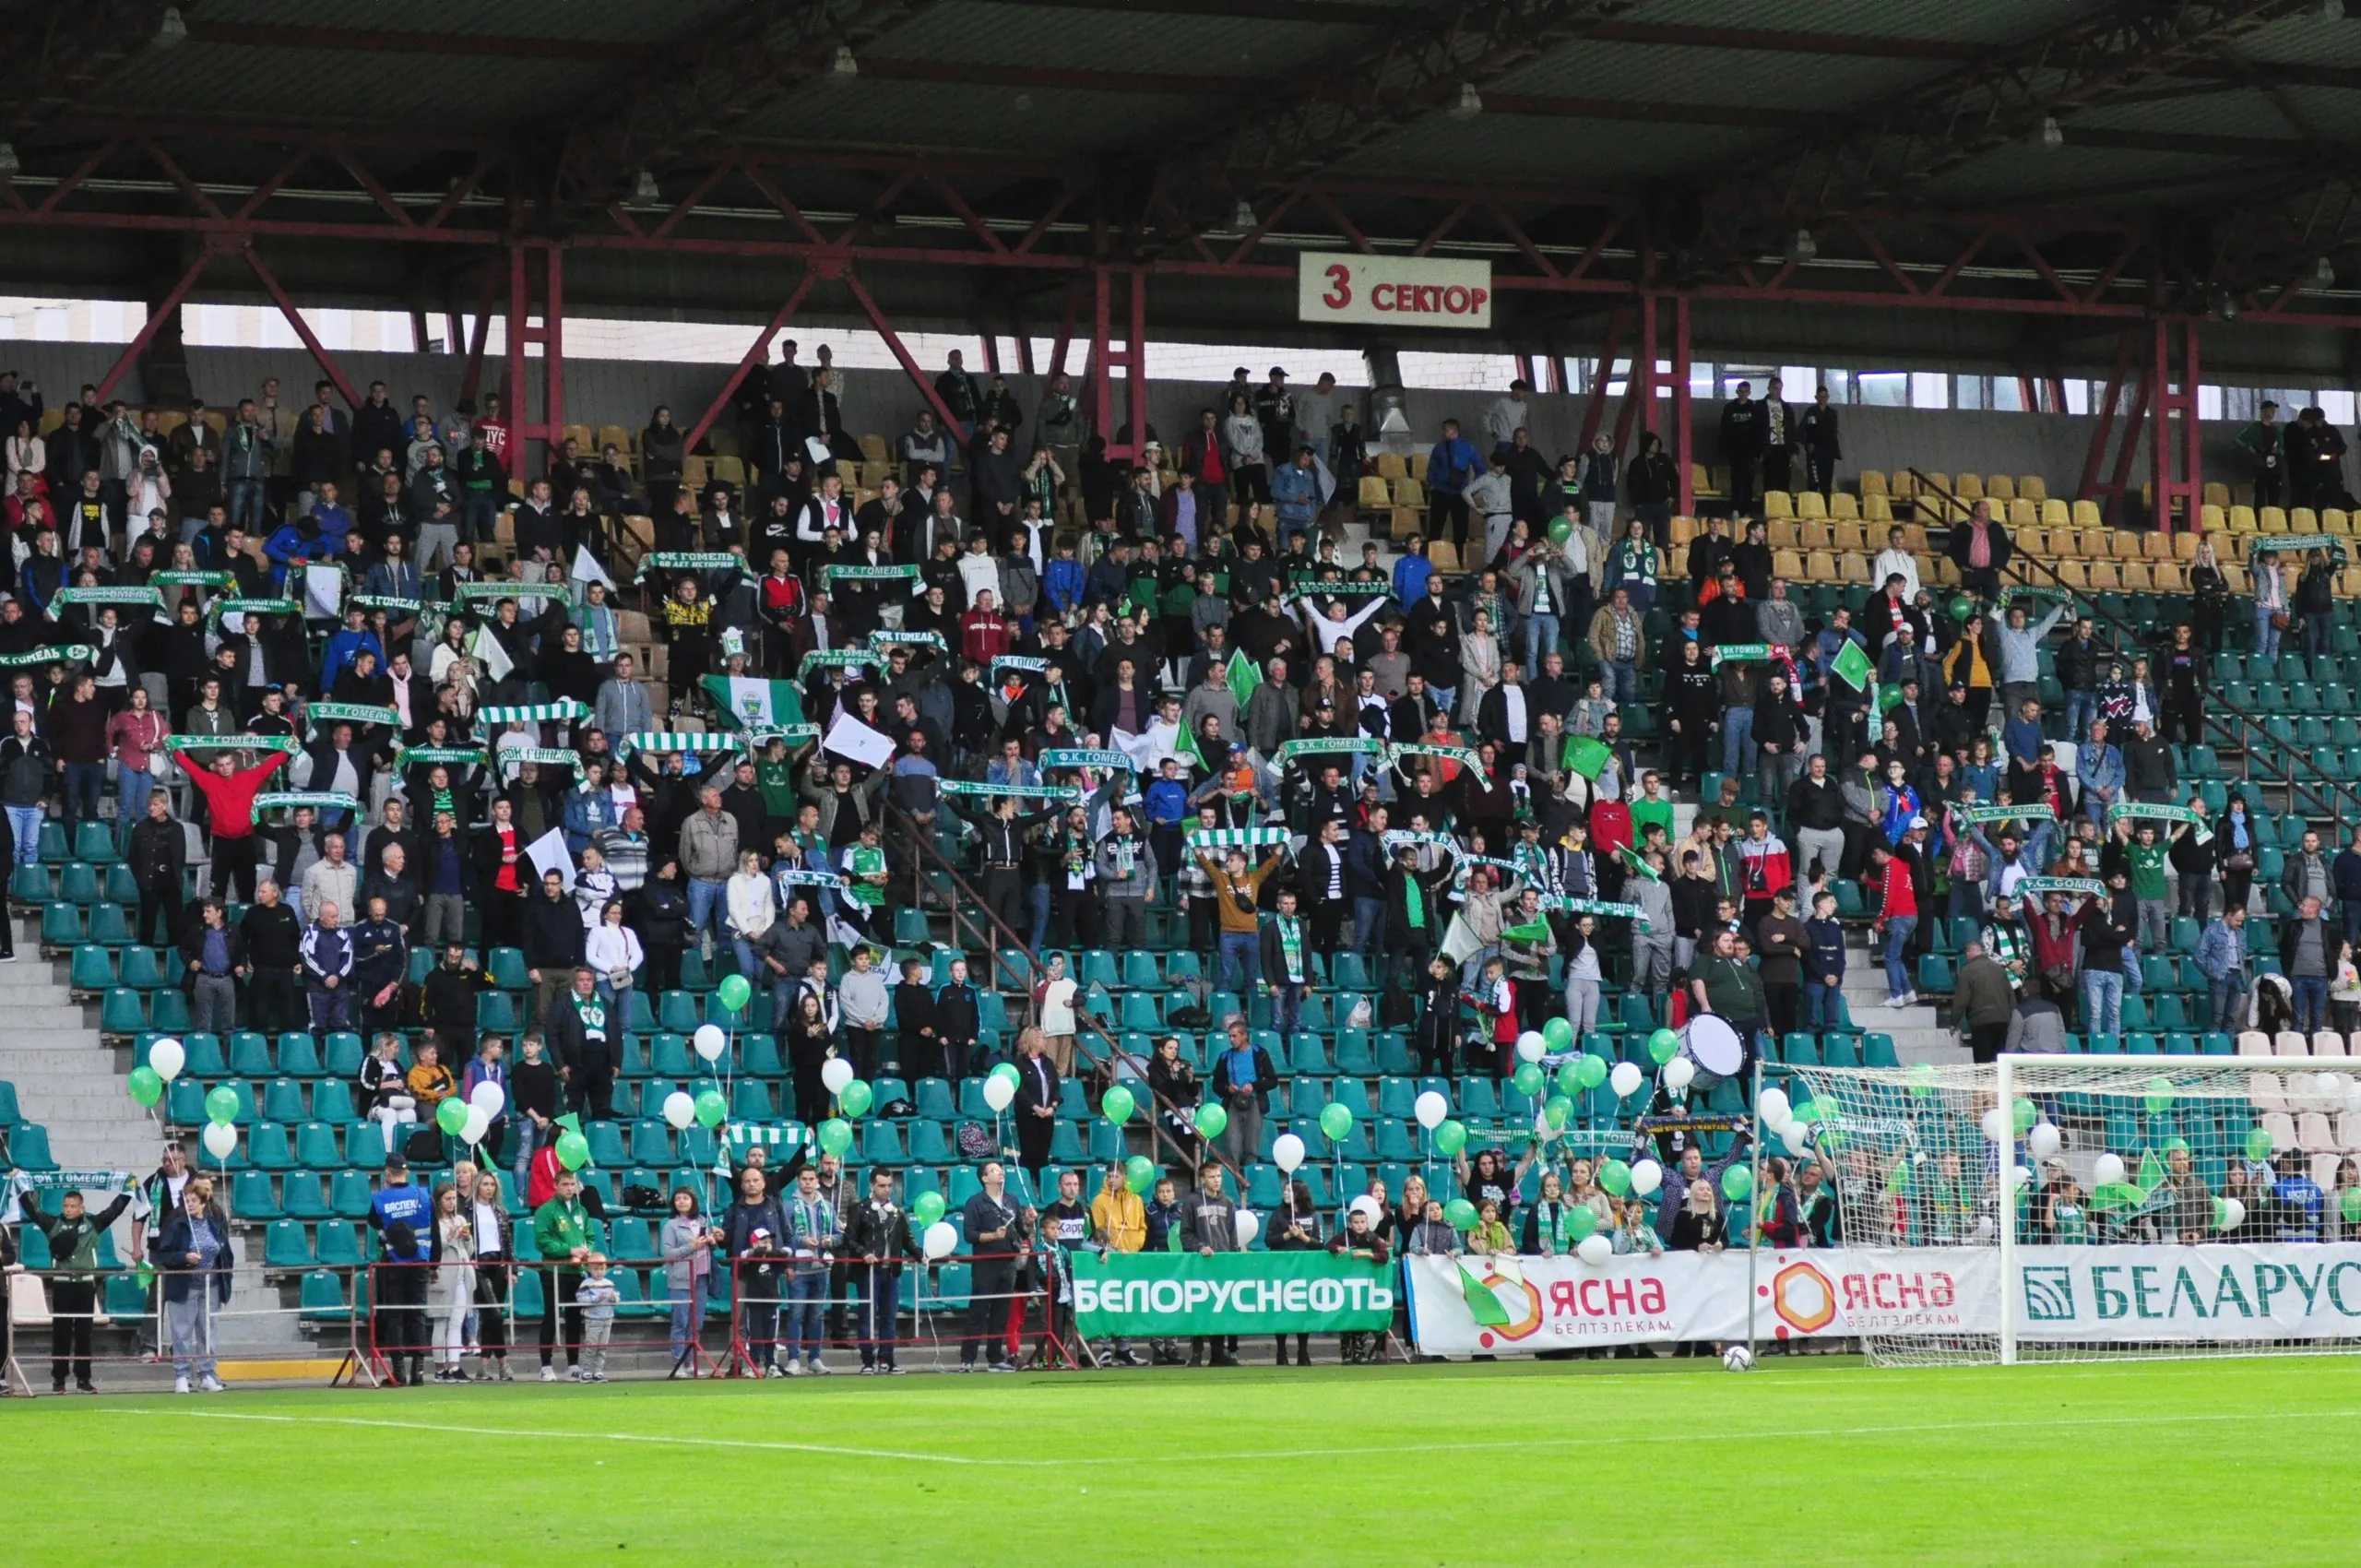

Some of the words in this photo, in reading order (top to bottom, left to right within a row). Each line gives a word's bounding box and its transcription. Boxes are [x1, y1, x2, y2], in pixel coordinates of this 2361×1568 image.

[1323, 264, 1352, 310] 3
[1370, 283, 1489, 315] СЕКТОР
[681, 552, 735, 562] ГОМЕЛЬ
[860, 565, 905, 576] ГОМЕЛЬ
[375, 596, 421, 610] ГОМЕЛЬ
[895, 632, 935, 643] ГОМЕЛЬ
[12, 647, 61, 665] ГОМЕЛЬ
[1735, 646, 1764, 654] ГОМЕЛЬ
[317, 705, 341, 715] Ф.К.
[344, 707, 391, 721] ГОМЕЛЬ
[213, 735, 269, 744] ГОМЕЛЬ
[1296, 742, 1319, 750] Ф.К.
[1322, 739, 1367, 749] ГОМЕЛЬ
[1058, 752, 1083, 762] Ф.К.
[2008, 805, 2055, 816] ГОМЕЛЬ
[2119, 805, 2140, 814] Ф.К.
[2142, 806, 2187, 818] ГОМЕЛЬ
[2052, 878, 2102, 893] GOMEL
[1602, 1134, 1636, 1145] ГОМЕ
[59, 1174, 106, 1183] ГОМЕЛЬ
[385, 1199, 421, 1215] БЯСПЕК
[391, 1209, 417, 1218] SECURITY
[1061, 1222, 1085, 1235] Kapp
[1074, 1277, 1394, 1313] БЕЛОРУСНЕФТЬ
[1846, 1313, 1961, 1329] БЕЛТЭЛЕКАМ
[1554, 1320, 1673, 1335] БЕЛТЭЛЕКАМ
